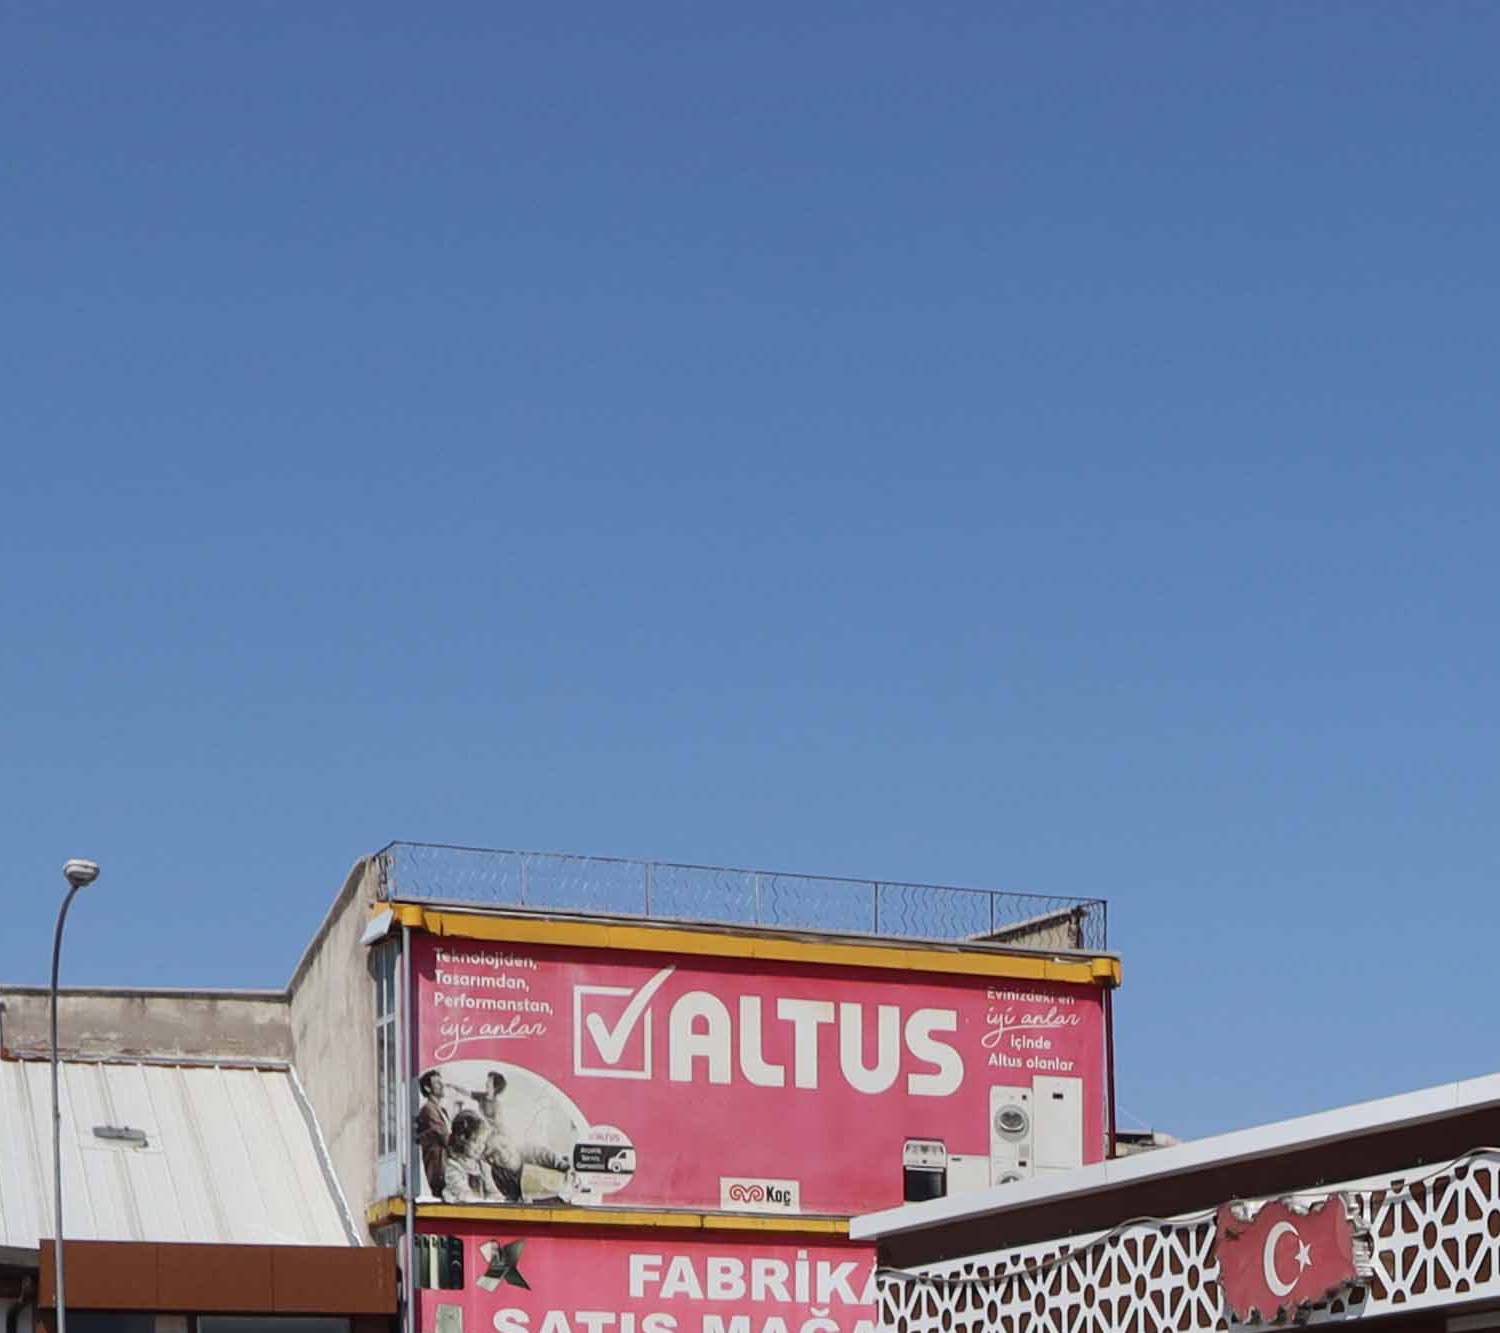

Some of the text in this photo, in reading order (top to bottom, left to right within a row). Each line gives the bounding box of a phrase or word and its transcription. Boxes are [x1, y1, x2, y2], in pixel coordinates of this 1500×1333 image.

[434, 969, 530, 992] Tasarımdan,
[434, 992, 553, 1015] Performanstan,
[479, 1015, 546, 1037] anlar
[669, 990, 964, 1096] ALTUS
[988, 1052, 1074, 1071] Altus olanlar
[766, 1185, 791, 1206] Koç
